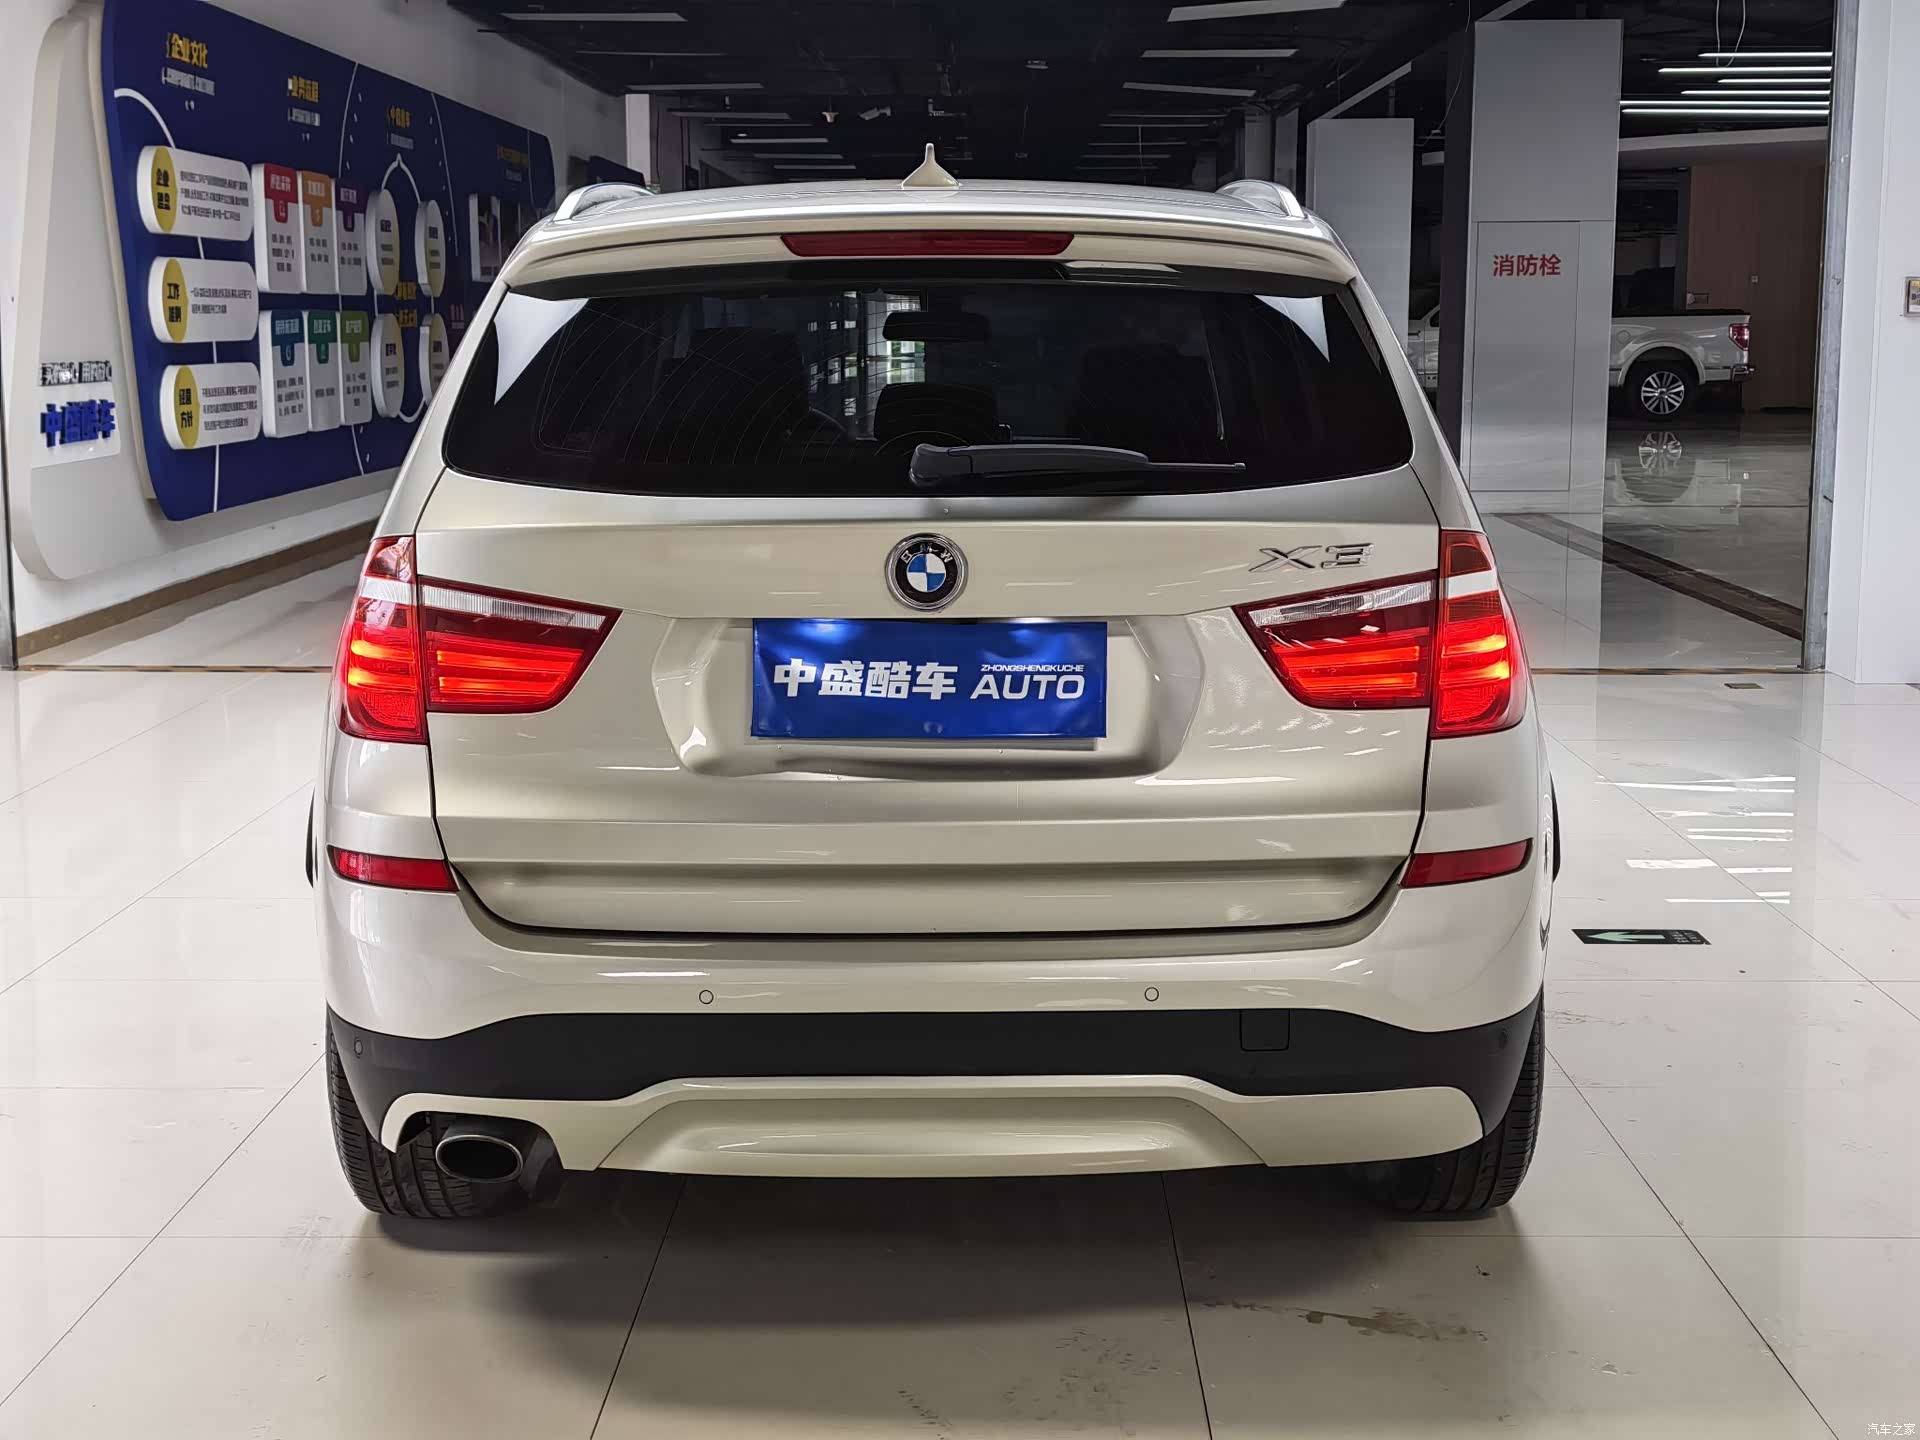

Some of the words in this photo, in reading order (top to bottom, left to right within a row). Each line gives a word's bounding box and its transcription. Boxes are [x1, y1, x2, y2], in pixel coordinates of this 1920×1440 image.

[171, 33, 208, 68] 企业文化
[1493, 253, 1561, 277] 消防栓
[167, 283, 181, 300] 工作
[1248, 543, 1374, 572] X3
[773, 658, 958, 700] 中盛酷车
[981, 664, 1085, 672] ZHONGSHENGKUCHE
[970, 674, 1085, 700] AUTO
